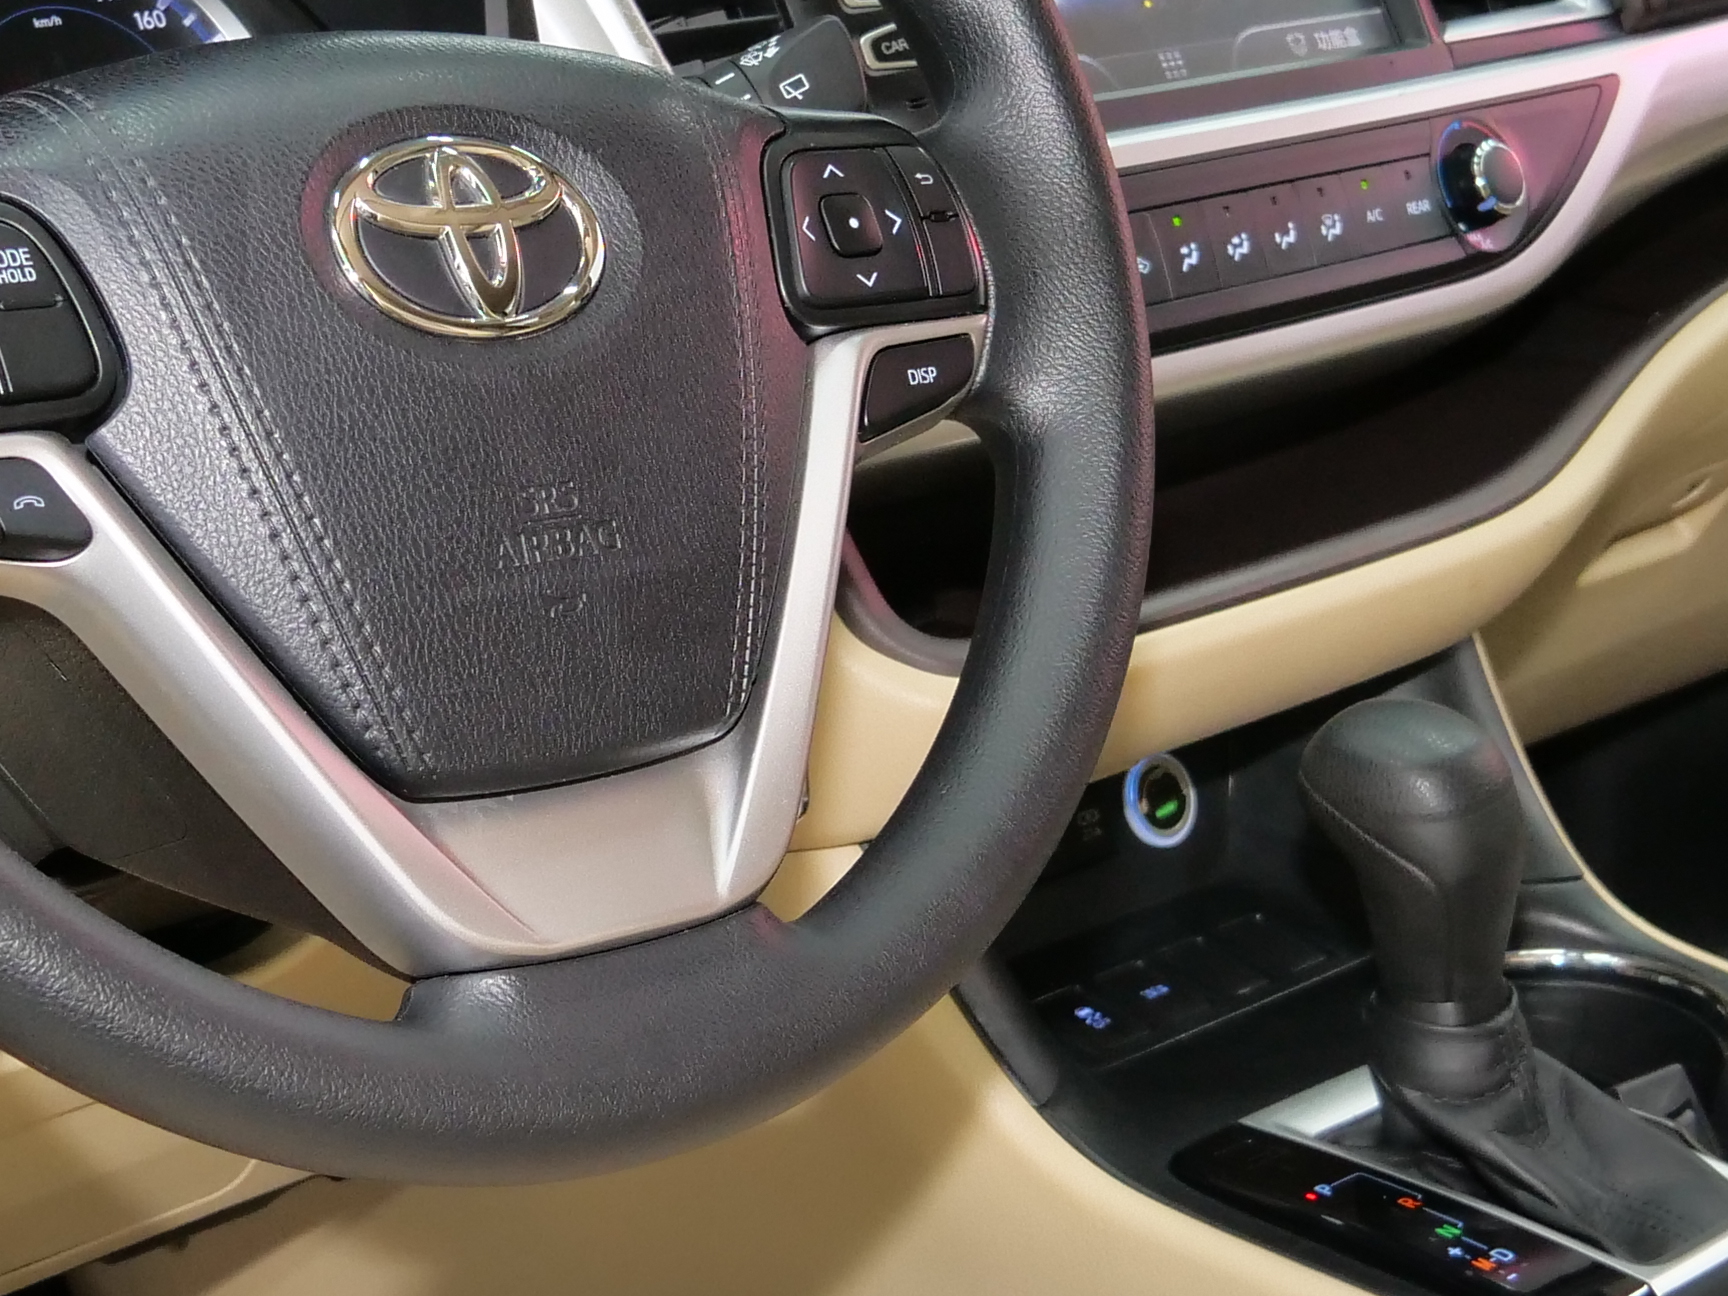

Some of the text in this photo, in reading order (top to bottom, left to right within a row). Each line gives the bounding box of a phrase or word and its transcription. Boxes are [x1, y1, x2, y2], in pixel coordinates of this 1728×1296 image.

[32, 15, 63, 29] km/h
[133, 9, 167, 31] 160
[881, 38, 910, 55] CAR
[1365, 207, 1385, 225] A/C
[1405, 198, 1432, 218] REAR
[907, 366, 938, 387] DISP
[1313, 1183, 1333, 1197] P
[1397, 1197, 1423, 1209] R
[1435, 1224, 1463, 1239] N
[1489, 1247, 1515, 1263] D
